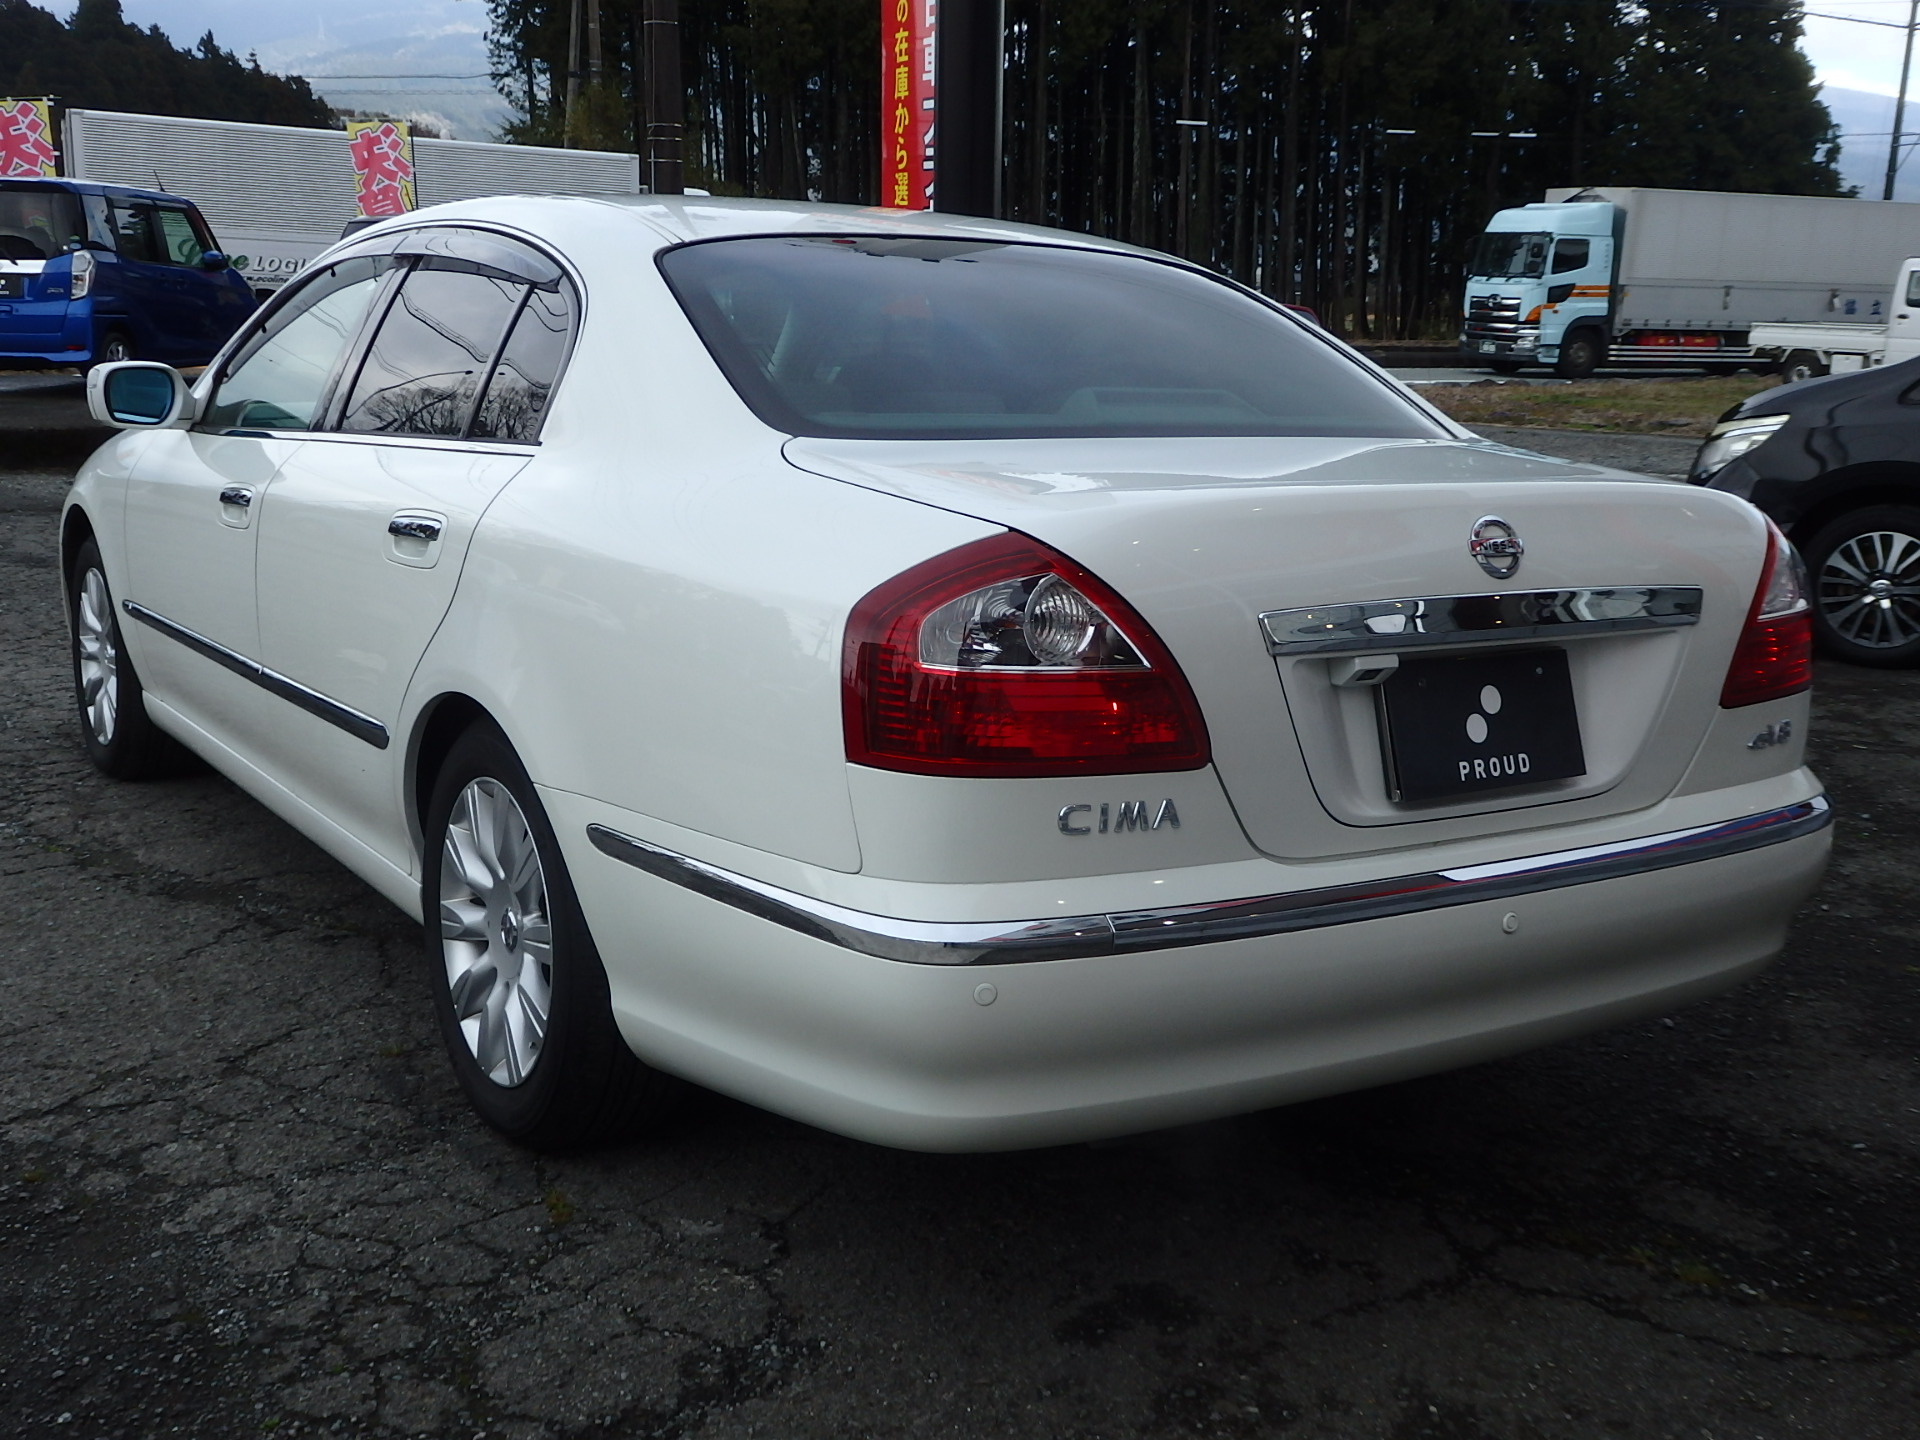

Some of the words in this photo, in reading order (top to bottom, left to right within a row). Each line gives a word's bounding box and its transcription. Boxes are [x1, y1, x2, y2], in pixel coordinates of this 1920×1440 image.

[894, 0, 909, 206] の在庫から選
[1458, 752, 1531, 782] PROUD
[1057, 798, 1181, 836] CIMA
